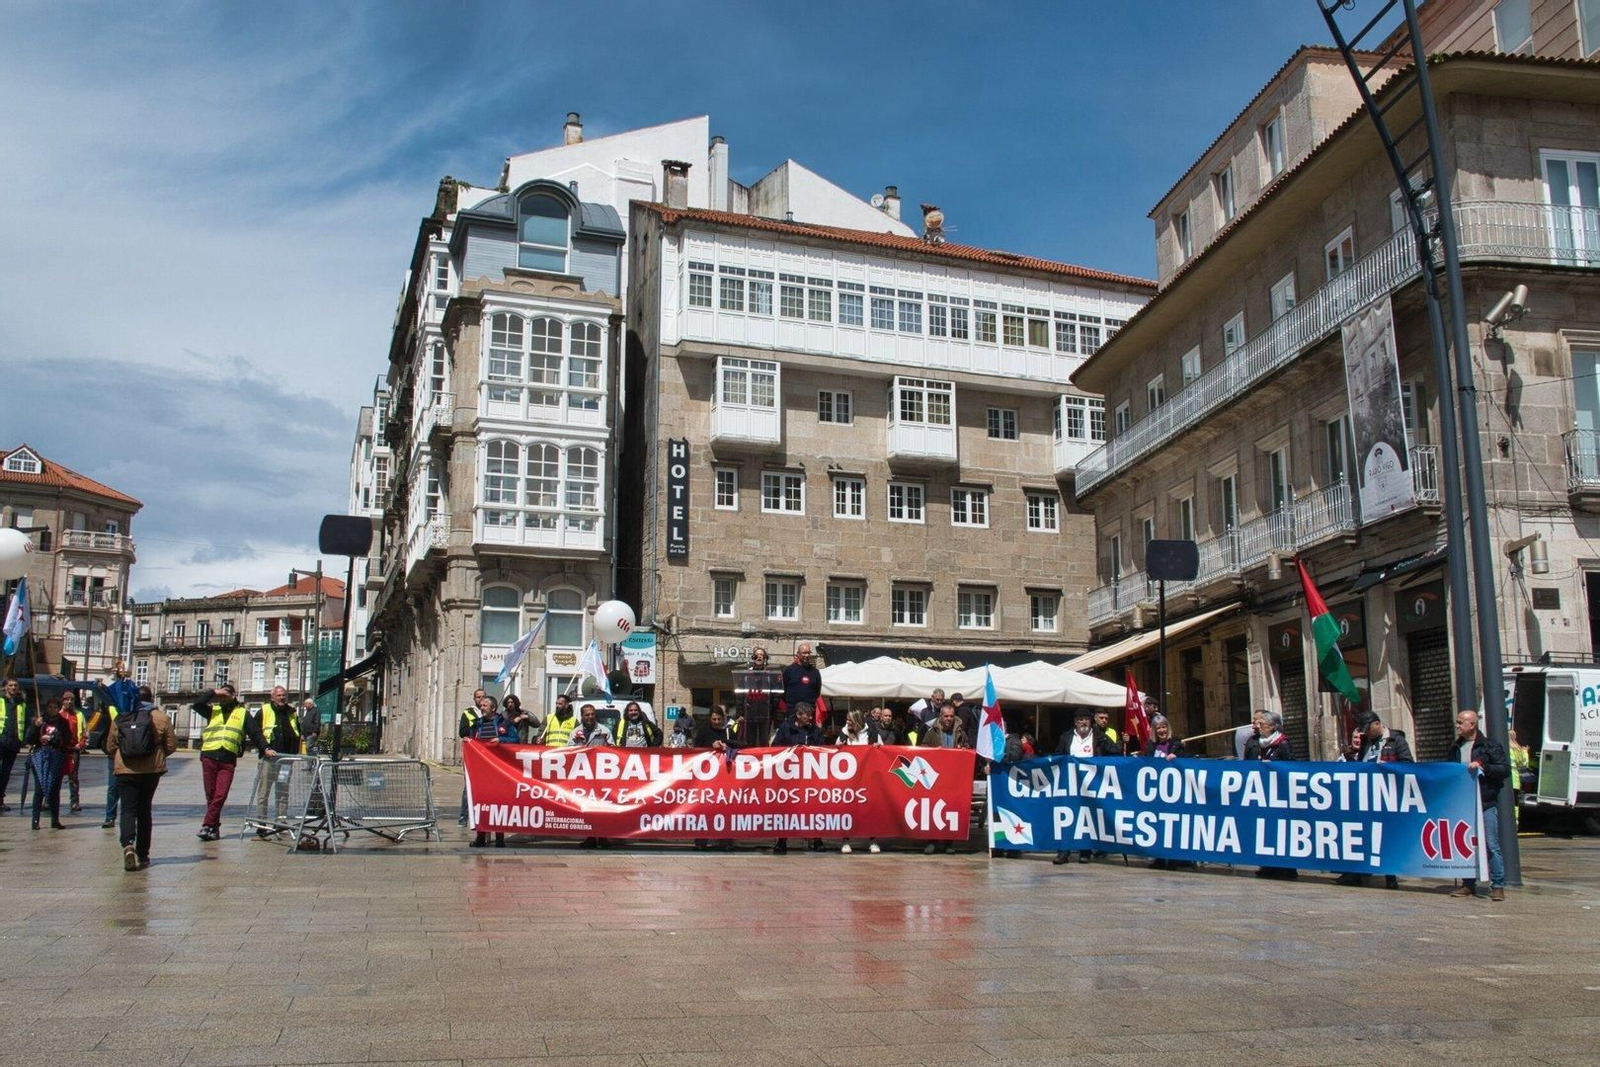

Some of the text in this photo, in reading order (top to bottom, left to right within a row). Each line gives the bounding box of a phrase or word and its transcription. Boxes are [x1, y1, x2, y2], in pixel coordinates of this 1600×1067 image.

[671, 444, 686, 541] HOTEL
[714, 647, 751, 658] HOT
[899, 656, 965, 669] Mahou
[1582, 684, 1600, 707] A
[670, 708, 676, 716] H
[516, 751, 858, 781] TRABALLO DIGNO
[516, 782, 567, 803] POLA
[572, 788, 613, 804] PAZ
[617, 788, 629, 804] E
[653, 787, 760, 805] SOBERANÍA
[765, 788, 801, 804] DOS
[805, 787, 868, 805] POBOS
[1008, 762, 1427, 814] GALIZA CON PALESTINA
[489, 804, 544, 828] MAIO
[640, 813, 853, 832] CONTRA O IMPERIALISMO
[904, 797, 959, 832] CIG
[1053, 806, 1383, 868] PALESTINA LIBRE!
[1421, 818, 1479, 861] CIG
